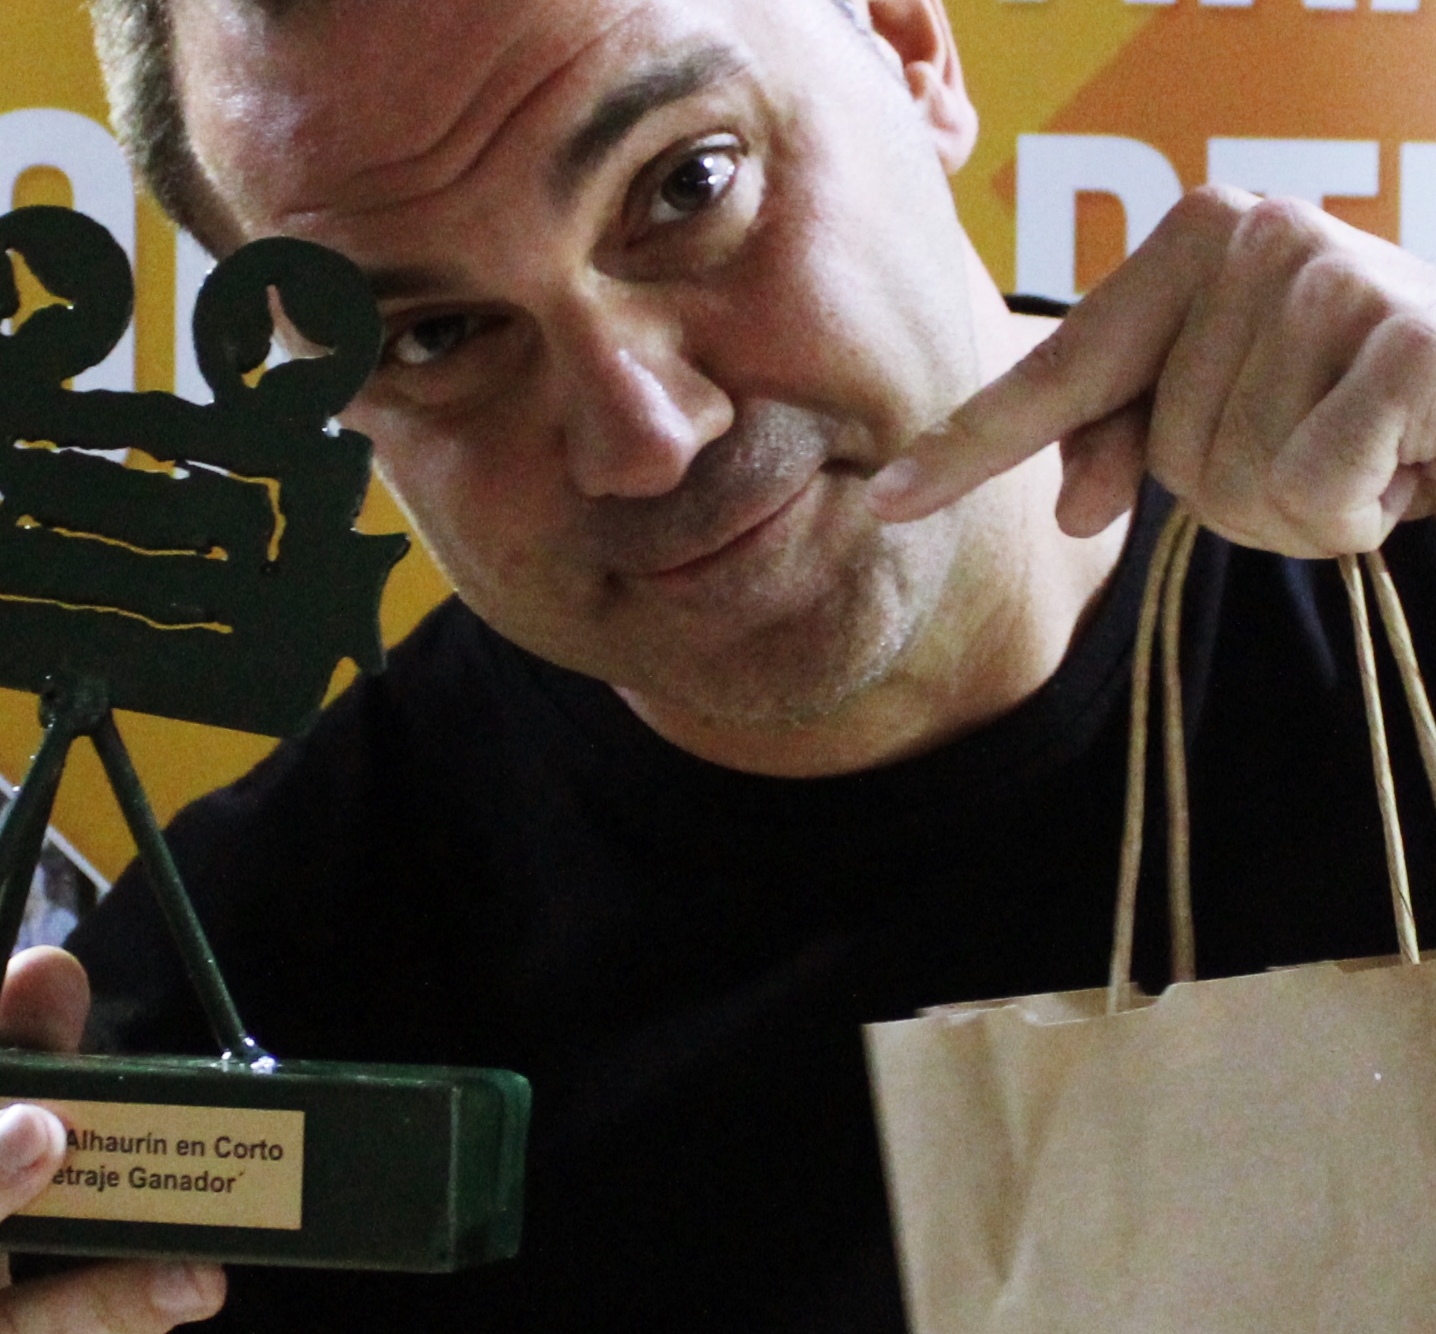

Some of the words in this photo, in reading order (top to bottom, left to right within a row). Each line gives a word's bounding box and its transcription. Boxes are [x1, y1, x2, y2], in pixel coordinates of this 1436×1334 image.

[176, 1139, 206, 1156] en
[214, 1136, 284, 1161] Corto
[52, 1166, 120, 1192] etraje
